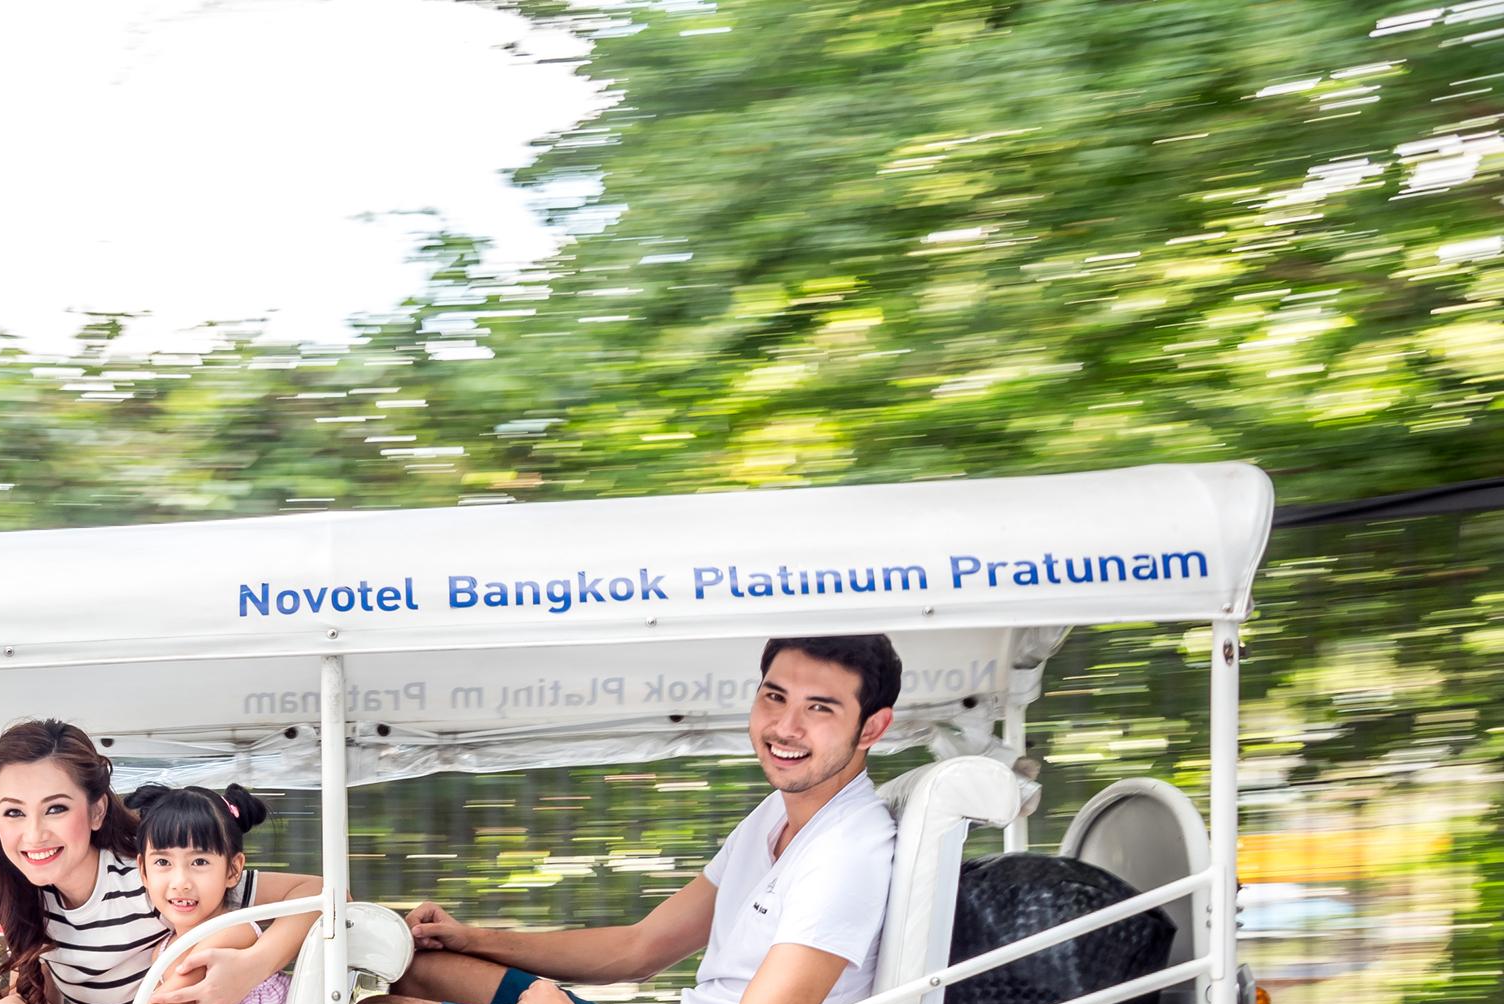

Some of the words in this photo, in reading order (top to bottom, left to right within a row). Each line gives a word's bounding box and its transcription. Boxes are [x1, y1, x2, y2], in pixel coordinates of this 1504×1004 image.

[239, 576, 419, 618] Novotel
[448, 568, 669, 614] Bangkok
[693, 563, 929, 600] Platinum
[950, 550, 1209, 589] Pratunam
